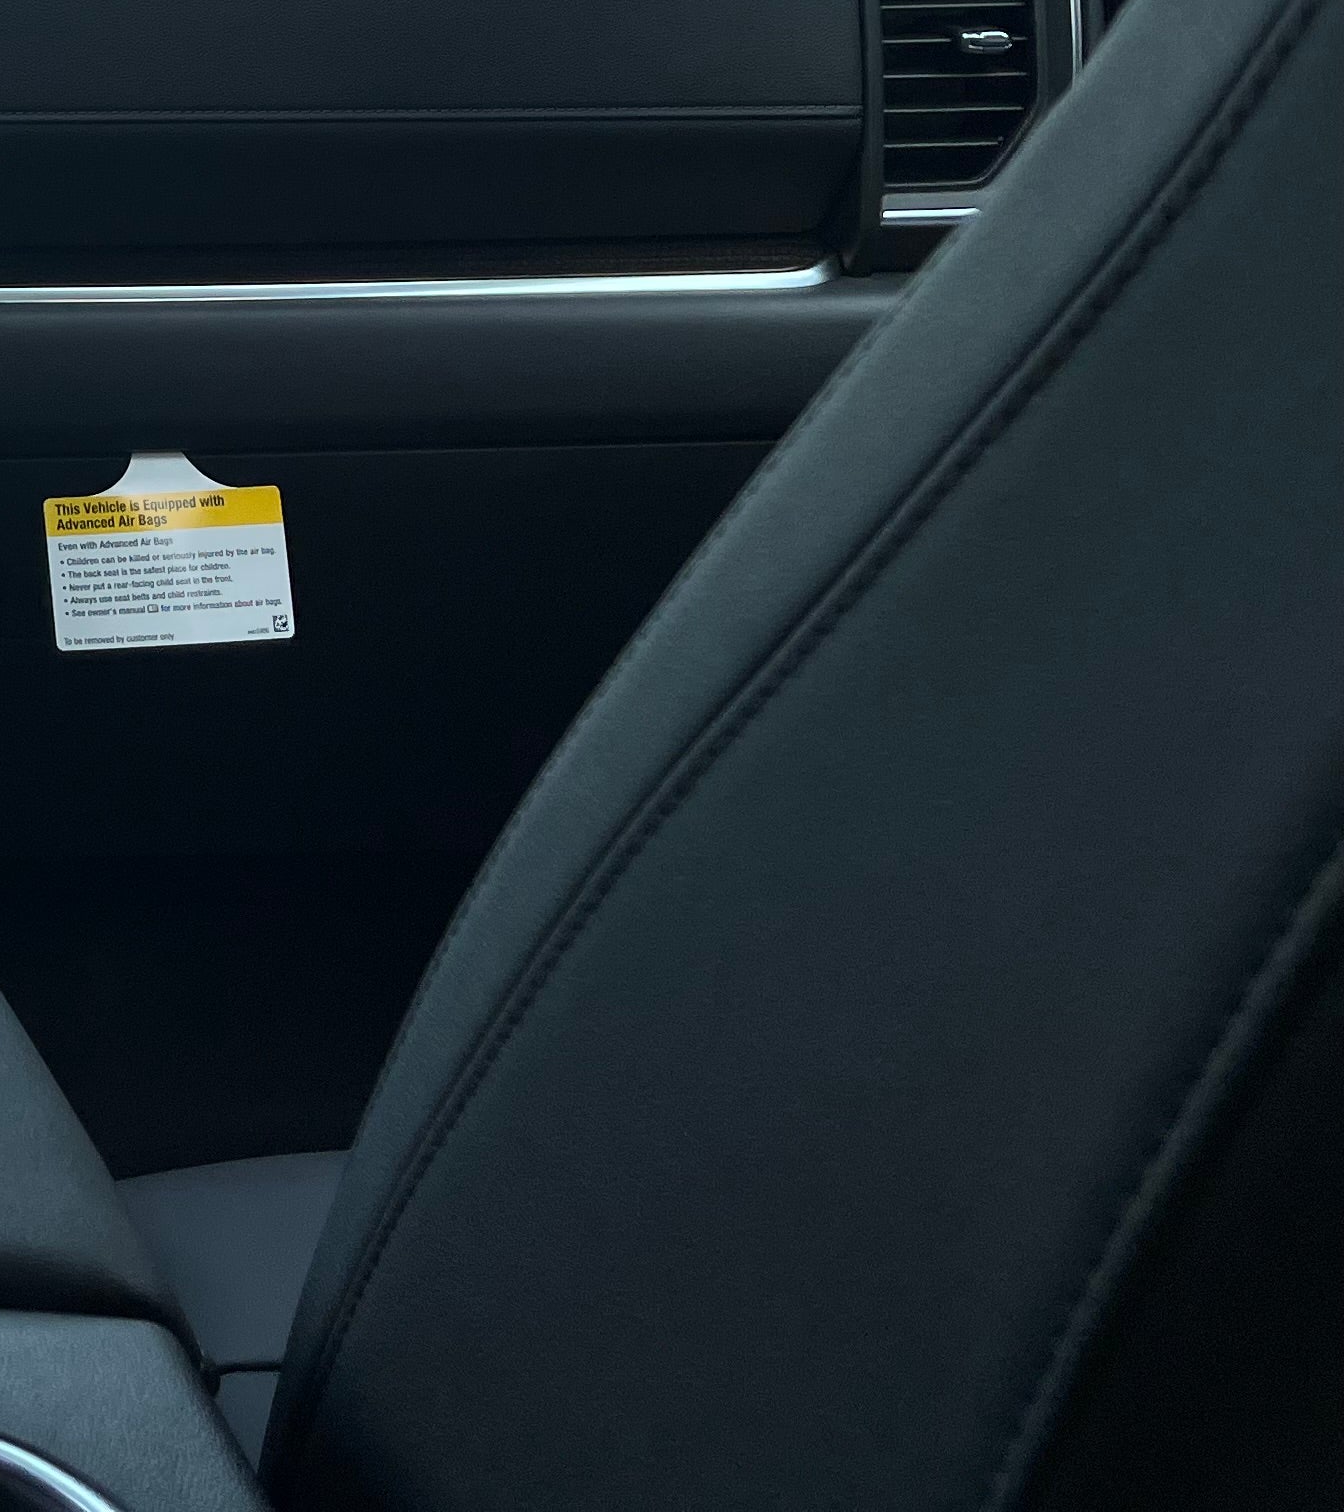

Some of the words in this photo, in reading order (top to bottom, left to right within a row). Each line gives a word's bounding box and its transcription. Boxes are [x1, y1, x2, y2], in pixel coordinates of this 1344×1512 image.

[55, 502, 81, 516] This
[83, 500, 127, 515] Vehicle
[129, 499, 140, 511] is
[143, 496, 196, 513] Equipped
[199, 494, 225, 508] with
[56, 516, 115, 531] Advanced
[118, 515, 135, 527] Air
[138, 514, 168, 527] Bags
[58, 542, 78, 552] Even
[80, 540, 97, 550] with
[99, 538, 139, 549] Advanced
[141, 537, 151, 546] Air
[153, 536, 173, 546] Bags
[66, 556, 100, 567] Children
[101, 556, 115, 564] can
[117, 555, 127, 563] be
[129, 553, 150, 563] killed
[162, 551, 196, 561] seriously
[198, 549, 224, 559] injured
[225, 548, 234, 557] by
[236, 548, 248, 556] the
[250, 547, 259, 555] air
[261, 546, 277, 555] bag.
[68, 570, 82, 579] The
[83, 569, 102, 578] back
[103, 569, 120, 577] seat
[121, 568, 128, 576] is
[129, 567, 142, 576] the
[143, 566, 166, 575] safest
[167, 565, 187, 575] place
[200, 562, 231, 571] children.
[69, 583, 91, 592] Never
[93, 582, 106, 592] put
[113, 579, 155, 590] rear-facing
[156, 577, 174, 587] child
[175, 577, 192, 586] seat
[193, 576, 200, 585] in
[201, 575, 213, 584] the
[214, 574, 233, 584] front.
[70, 596, 98, 606] Always
[99, 595, 113, 603] use
[114, 594, 131, 603] seat
[132, 592, 151, 602] belts
[152, 591, 166, 600] and
[167, 590, 186, 599] child
[187, 588, 223, 598] restraints.
[71, 609, 86, 618] See
[118, 606, 146, 615] manual
[160, 604, 171, 612] for
[193, 600, 233, 610] information
[234, 599, 254, 608] about
[255, 598, 264, 606] air
[63, 637, 73, 646] To
[73, 636, 83, 645] be
[84, 634, 115, 645] removed
[116, 634, 125, 644] by
[126, 633, 158, 643] customer
[159, 632, 175, 642] only
